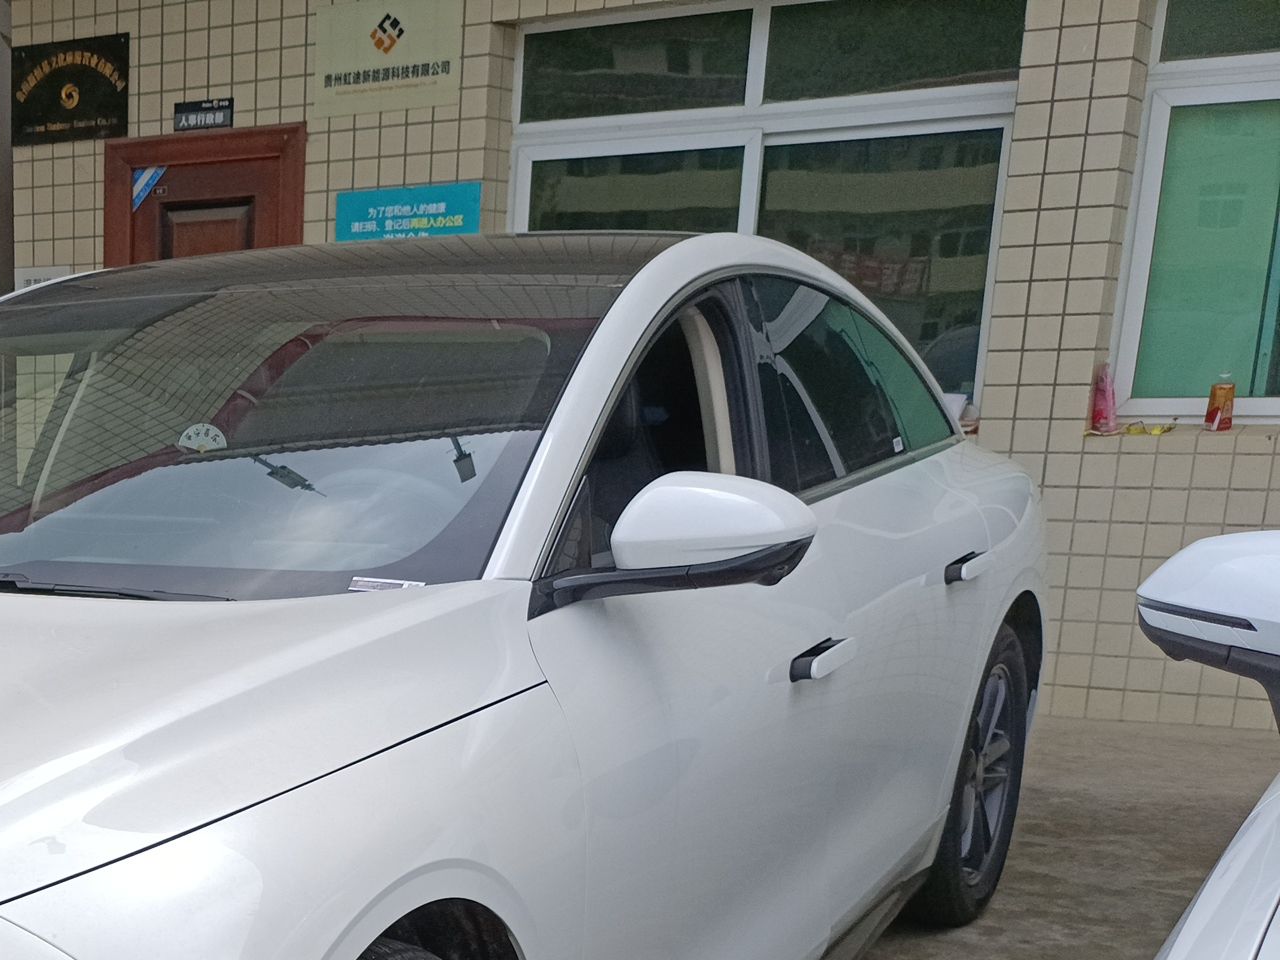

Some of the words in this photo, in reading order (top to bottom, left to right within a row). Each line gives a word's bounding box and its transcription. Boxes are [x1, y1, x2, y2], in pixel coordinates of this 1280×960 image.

[367, 202, 447, 218] 为了您和他人的健康
